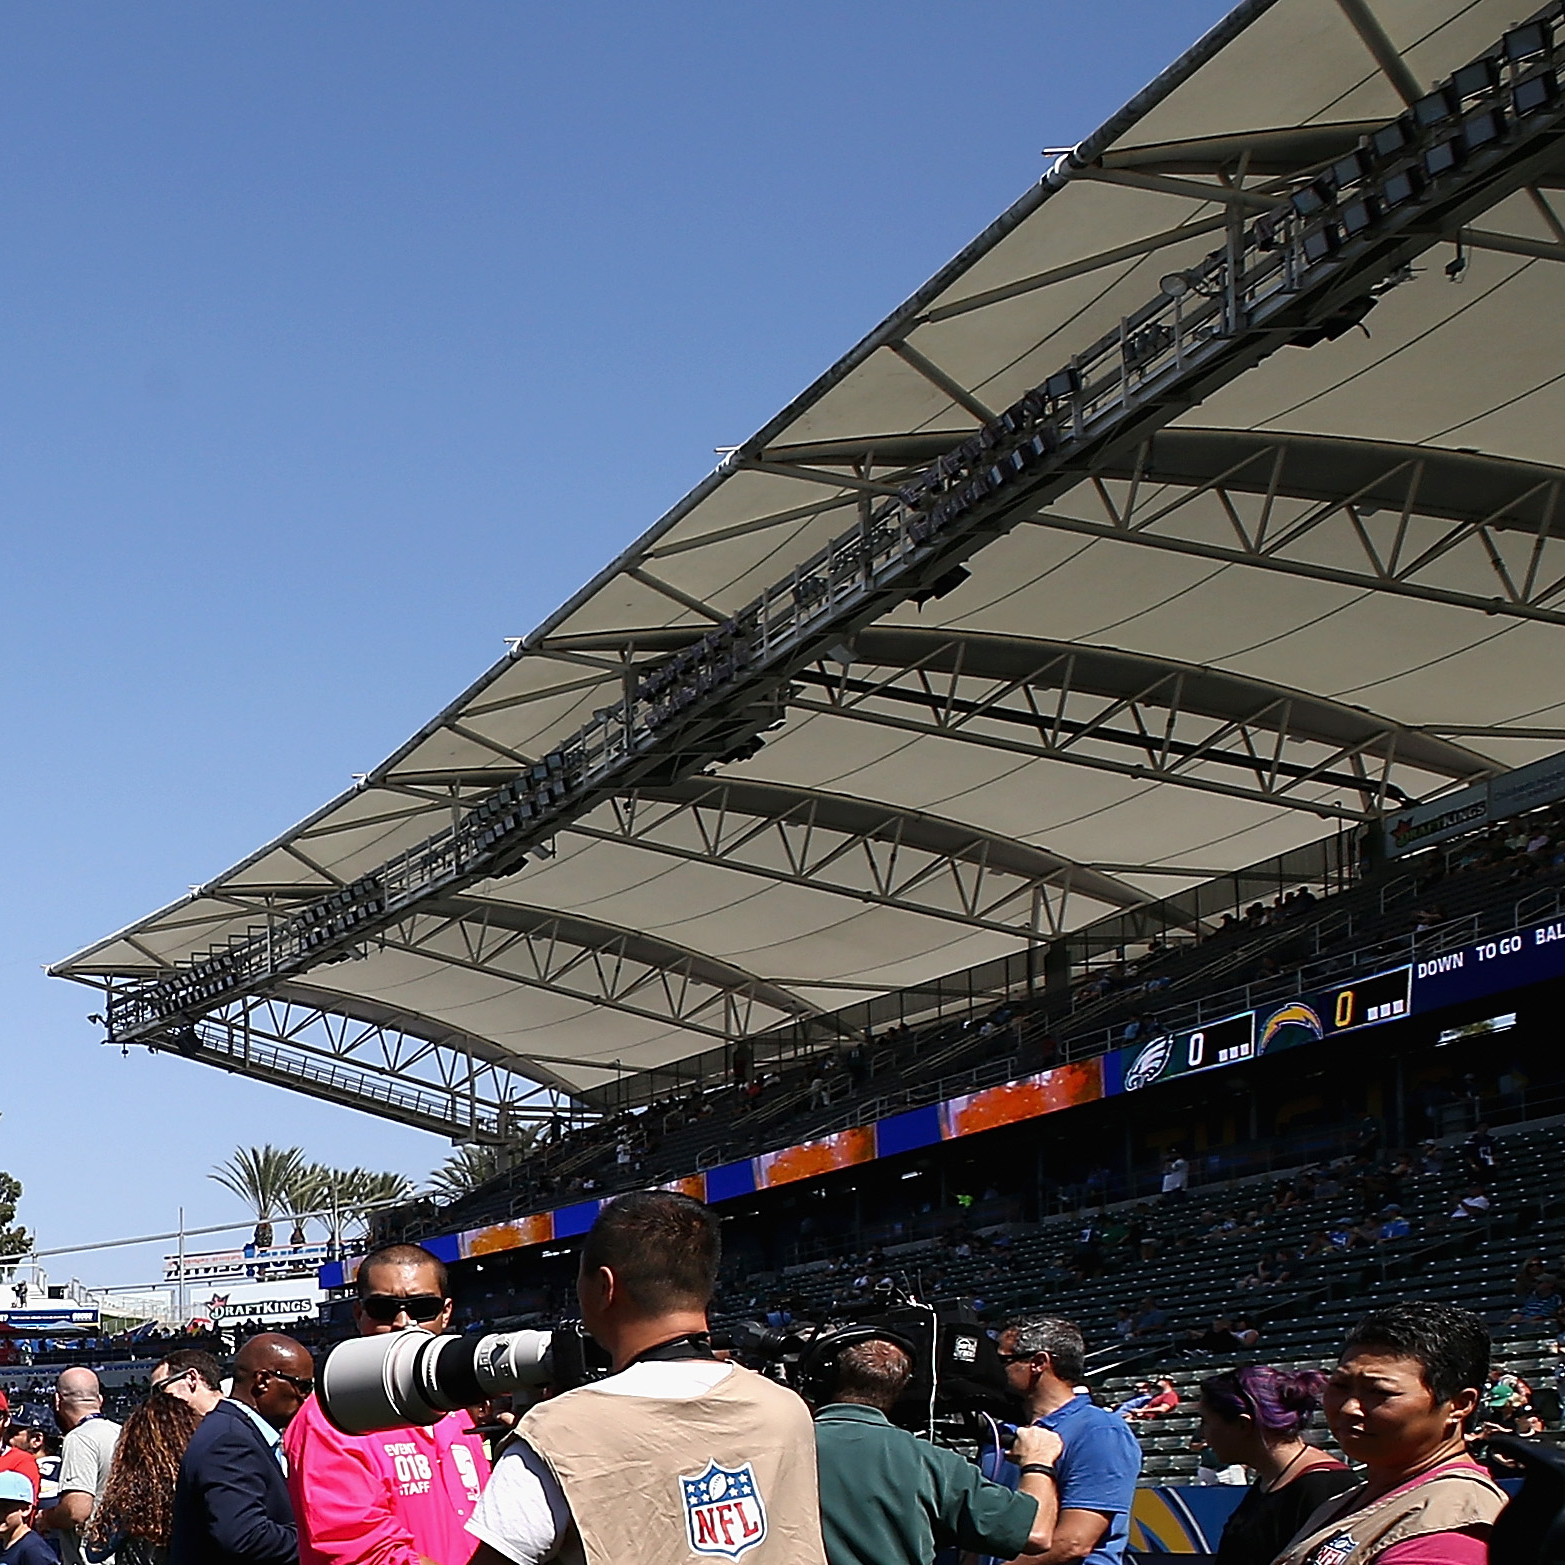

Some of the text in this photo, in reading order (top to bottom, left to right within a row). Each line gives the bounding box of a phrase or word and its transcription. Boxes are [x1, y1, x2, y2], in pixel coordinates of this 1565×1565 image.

[1418, 951, 1464, 979] DOWN
[1475, 943, 1496, 961] TO
[1500, 936, 1522, 955] GO
[1335, 990, 1355, 1027] 0
[1189, 1033, 1204, 1067] 0
[210, 1300, 312, 1320] DRAFTKINGS
[384, 1443, 417, 1456] EVENT
[394, 1454, 432, 1482] 018
[695, 1502, 759, 1545] NFL
